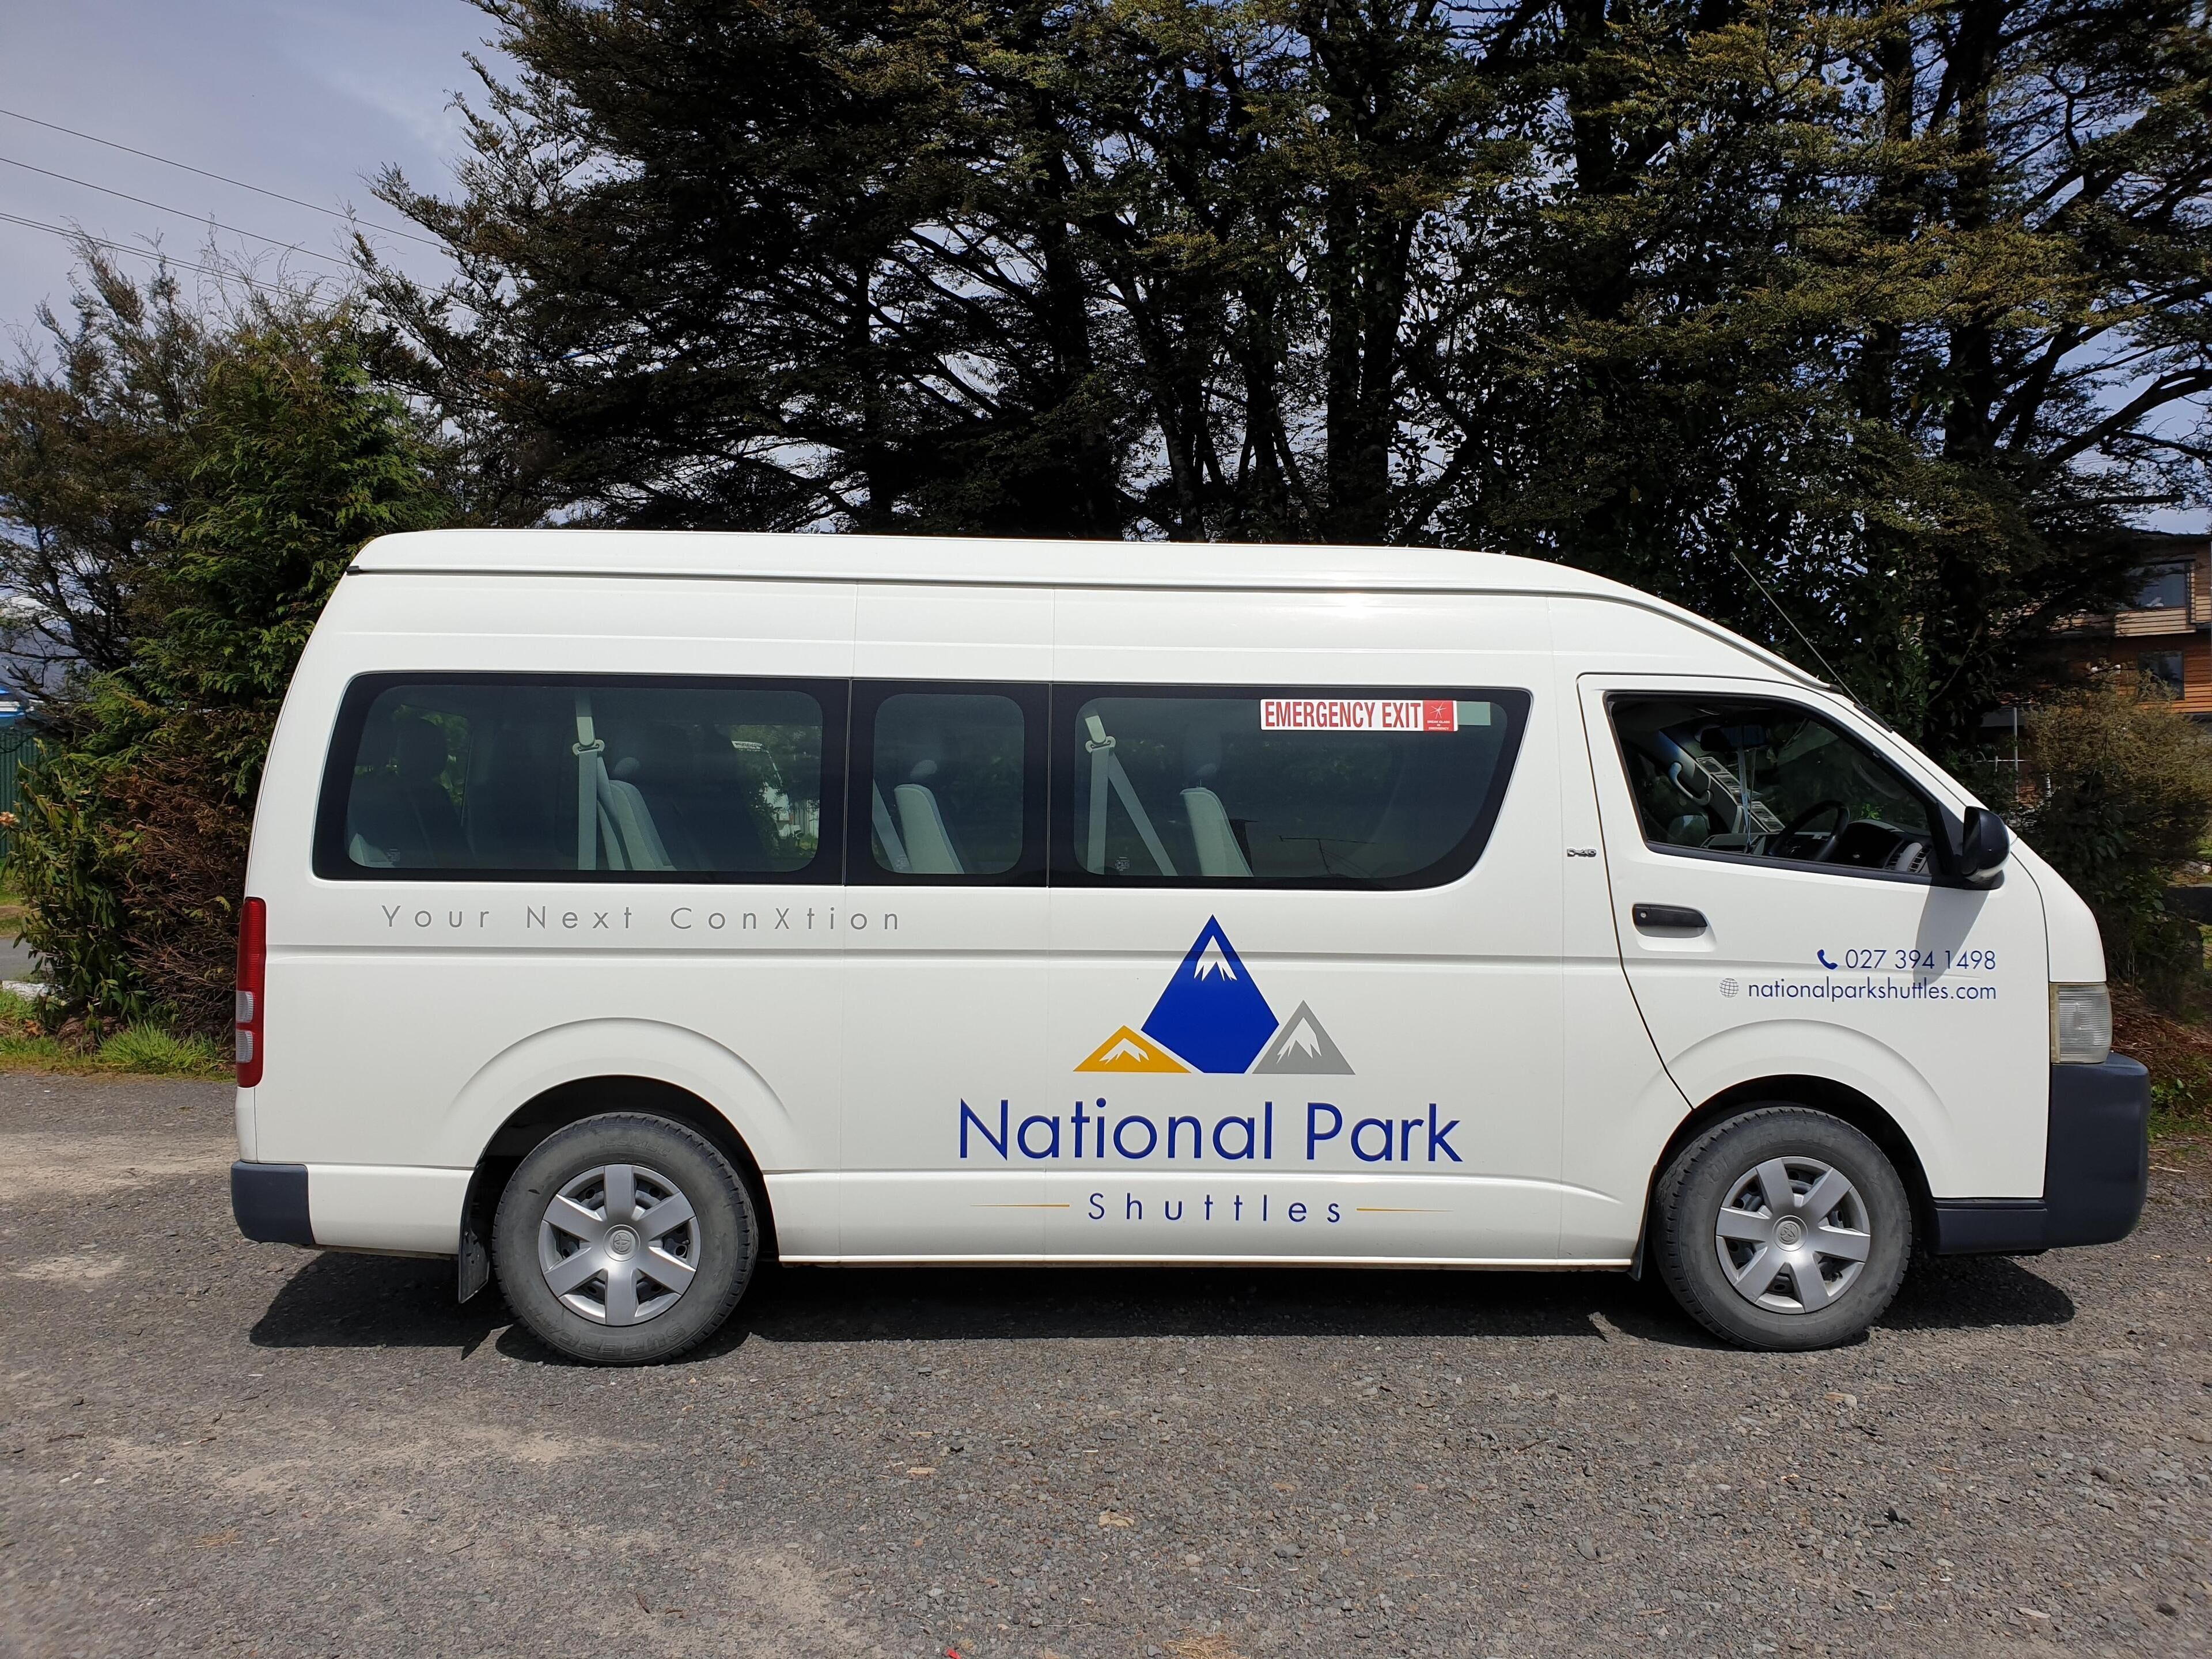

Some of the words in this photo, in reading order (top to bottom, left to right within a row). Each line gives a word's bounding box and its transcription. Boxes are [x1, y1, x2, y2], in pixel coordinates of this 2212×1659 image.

[1265, 702, 1375, 728] EMERGENCY
[1382, 702, 1421, 728] EXIT
[381, 905, 490, 928] Your
[527, 906, 632, 929] Next
[671, 907, 899, 930] ConXtion
[1845, 949, 1888, 969] 027
[1894, 949, 1936, 969] 394
[1944, 950, 1997, 970] 1498
[1748, 976, 1997, 1002] nationalparkshuttles.com
[960, 1097, 1273, 1161] National
[1307, 1103, 1463, 1163] Park
[1088, 1192, 1341, 1223] Shuttles
